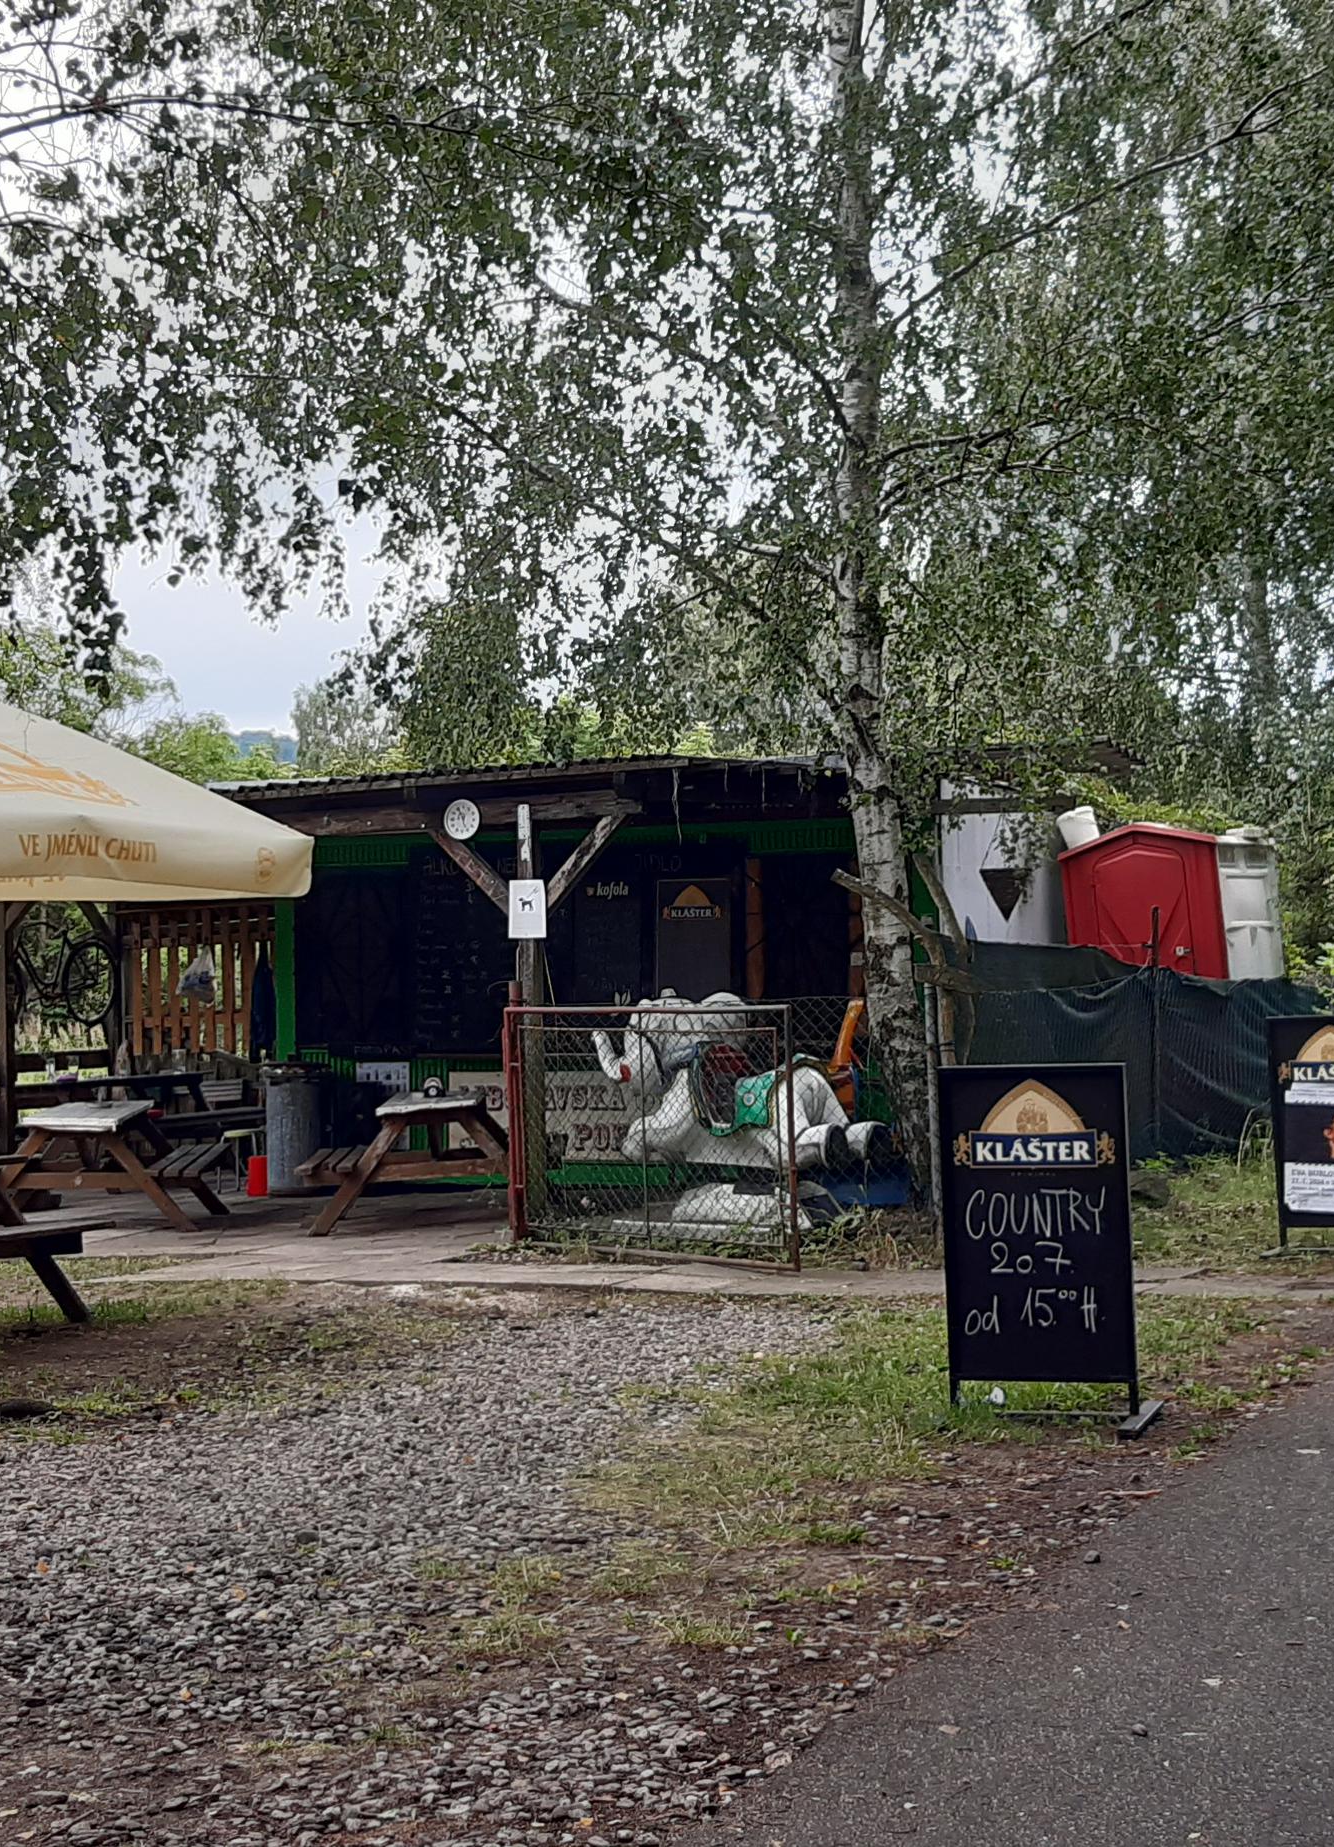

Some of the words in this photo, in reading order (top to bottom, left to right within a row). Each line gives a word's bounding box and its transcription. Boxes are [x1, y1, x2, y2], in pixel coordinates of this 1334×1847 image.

[18, 834, 41, 857] VE
[45, 828, 99, 862] JMÉNU
[105, 838, 156, 862] CHUTI
[596, 881, 629, 900] kofola
[975, 1138, 1092, 1162] KLÁŠTER
[965, 1186, 1106, 1240] COUNTRY
[964, 1293, 1001, 1336] od
